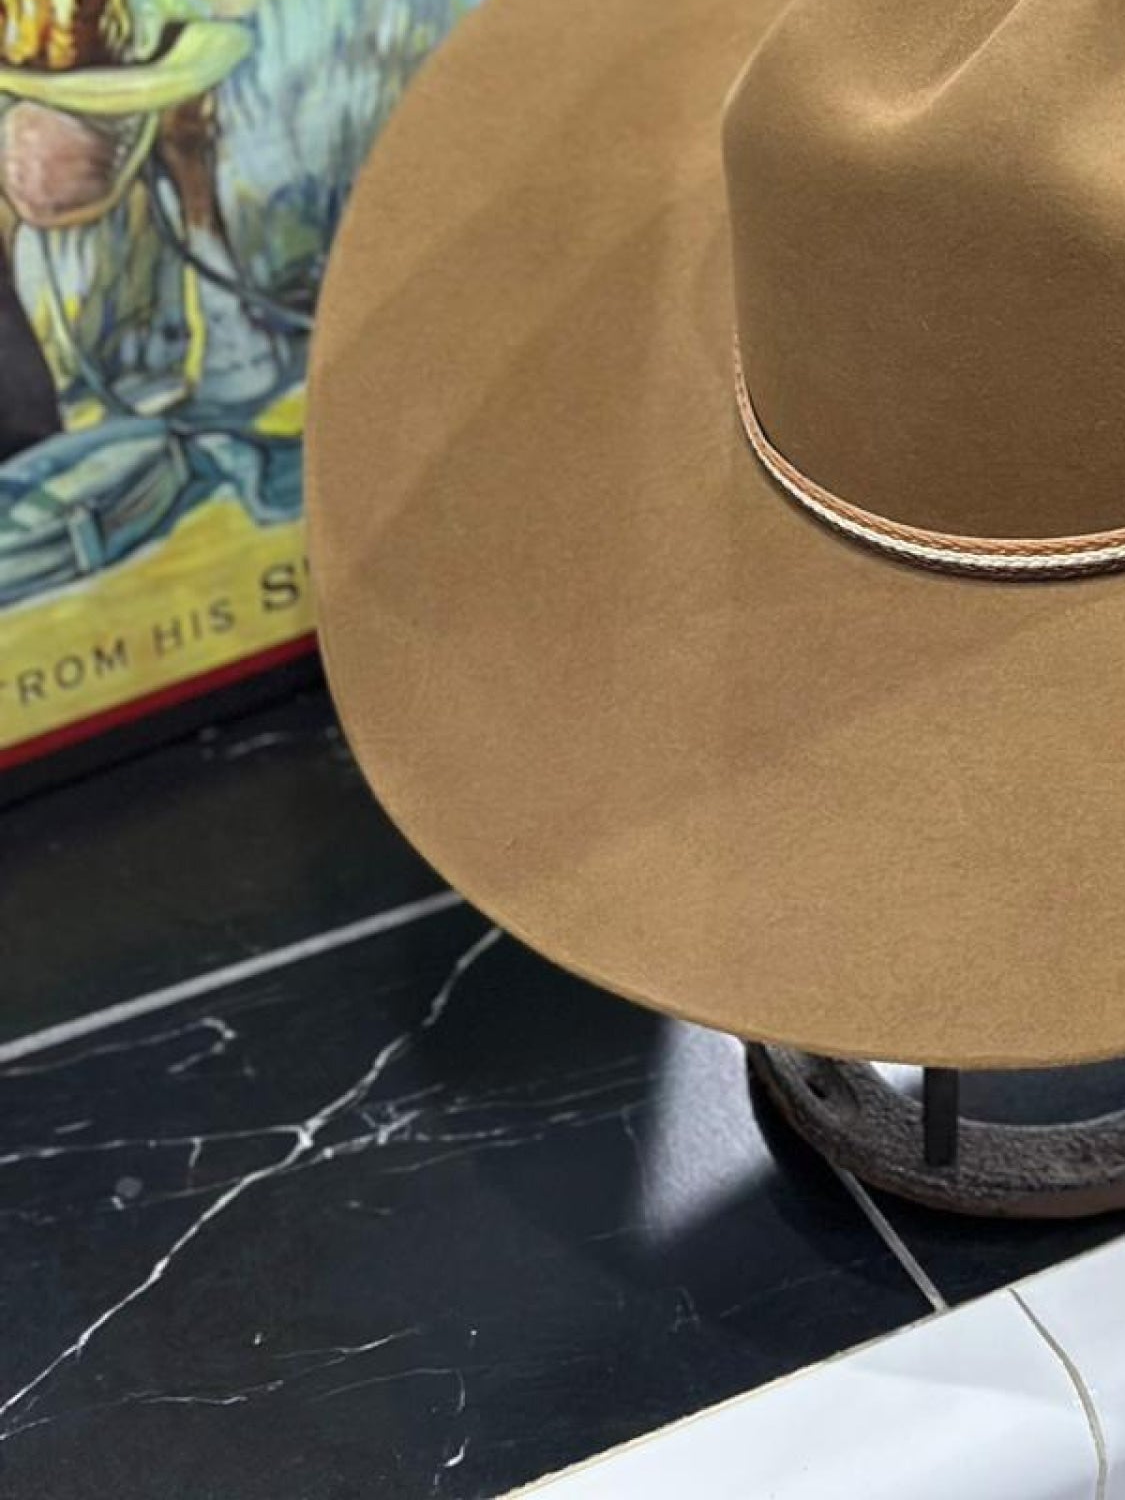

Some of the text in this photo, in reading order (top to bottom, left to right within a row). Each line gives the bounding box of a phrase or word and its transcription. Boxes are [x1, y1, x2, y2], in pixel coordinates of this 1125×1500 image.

[0, 557, 311, 706] ROM HIS S
